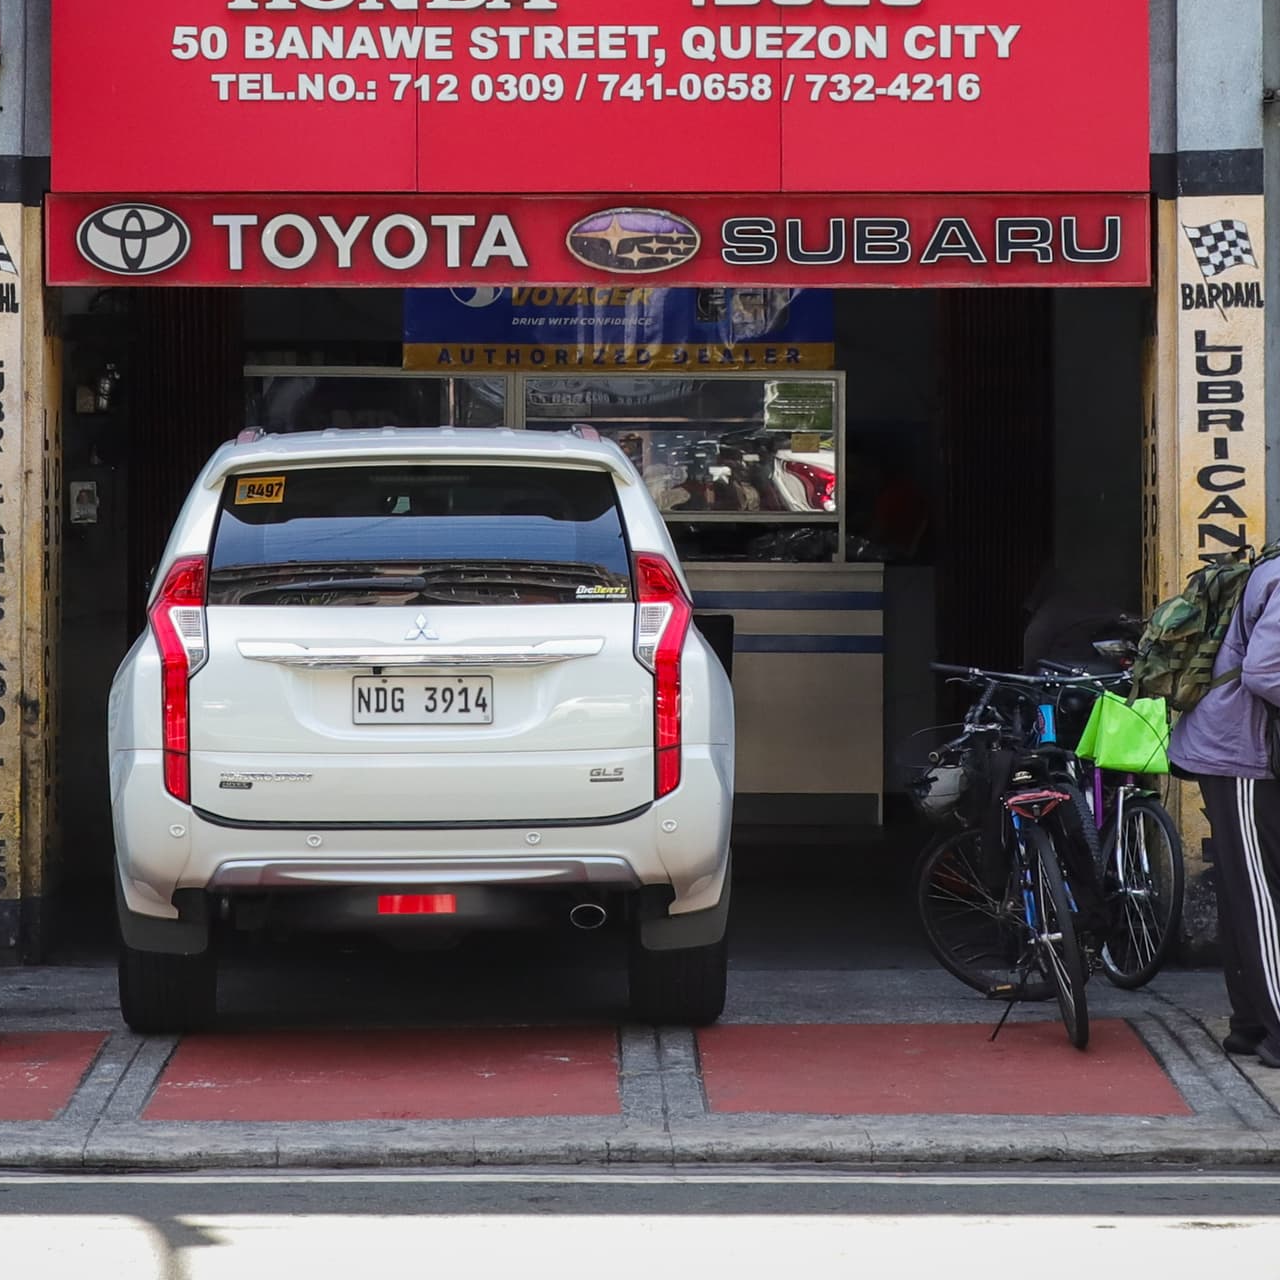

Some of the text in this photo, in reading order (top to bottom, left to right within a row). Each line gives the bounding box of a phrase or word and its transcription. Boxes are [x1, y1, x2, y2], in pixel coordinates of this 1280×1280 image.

[170, 24, 1021, 68] 50 BANAWE STREET, QUEZON CITY
[211, 72, 982, 104] TEL.NO.: 712 0309 / 741-0658 / 732-4216
[212, 213, 530, 271] TOYOTA
[721, 215, 1122, 267] SUBARU
[1181, 281, 1265, 311] BARDAHL
[511, 317, 545, 327] DRIVE
[547, 317, 580, 327] WITH
[437, 346, 803, 366] AUTHORIZED DEALER
[1194, 329, 1247, 566] LUBRICAN
[357, 686, 488, 713] NDG 3914
[589, 767, 625, 777] GLS
